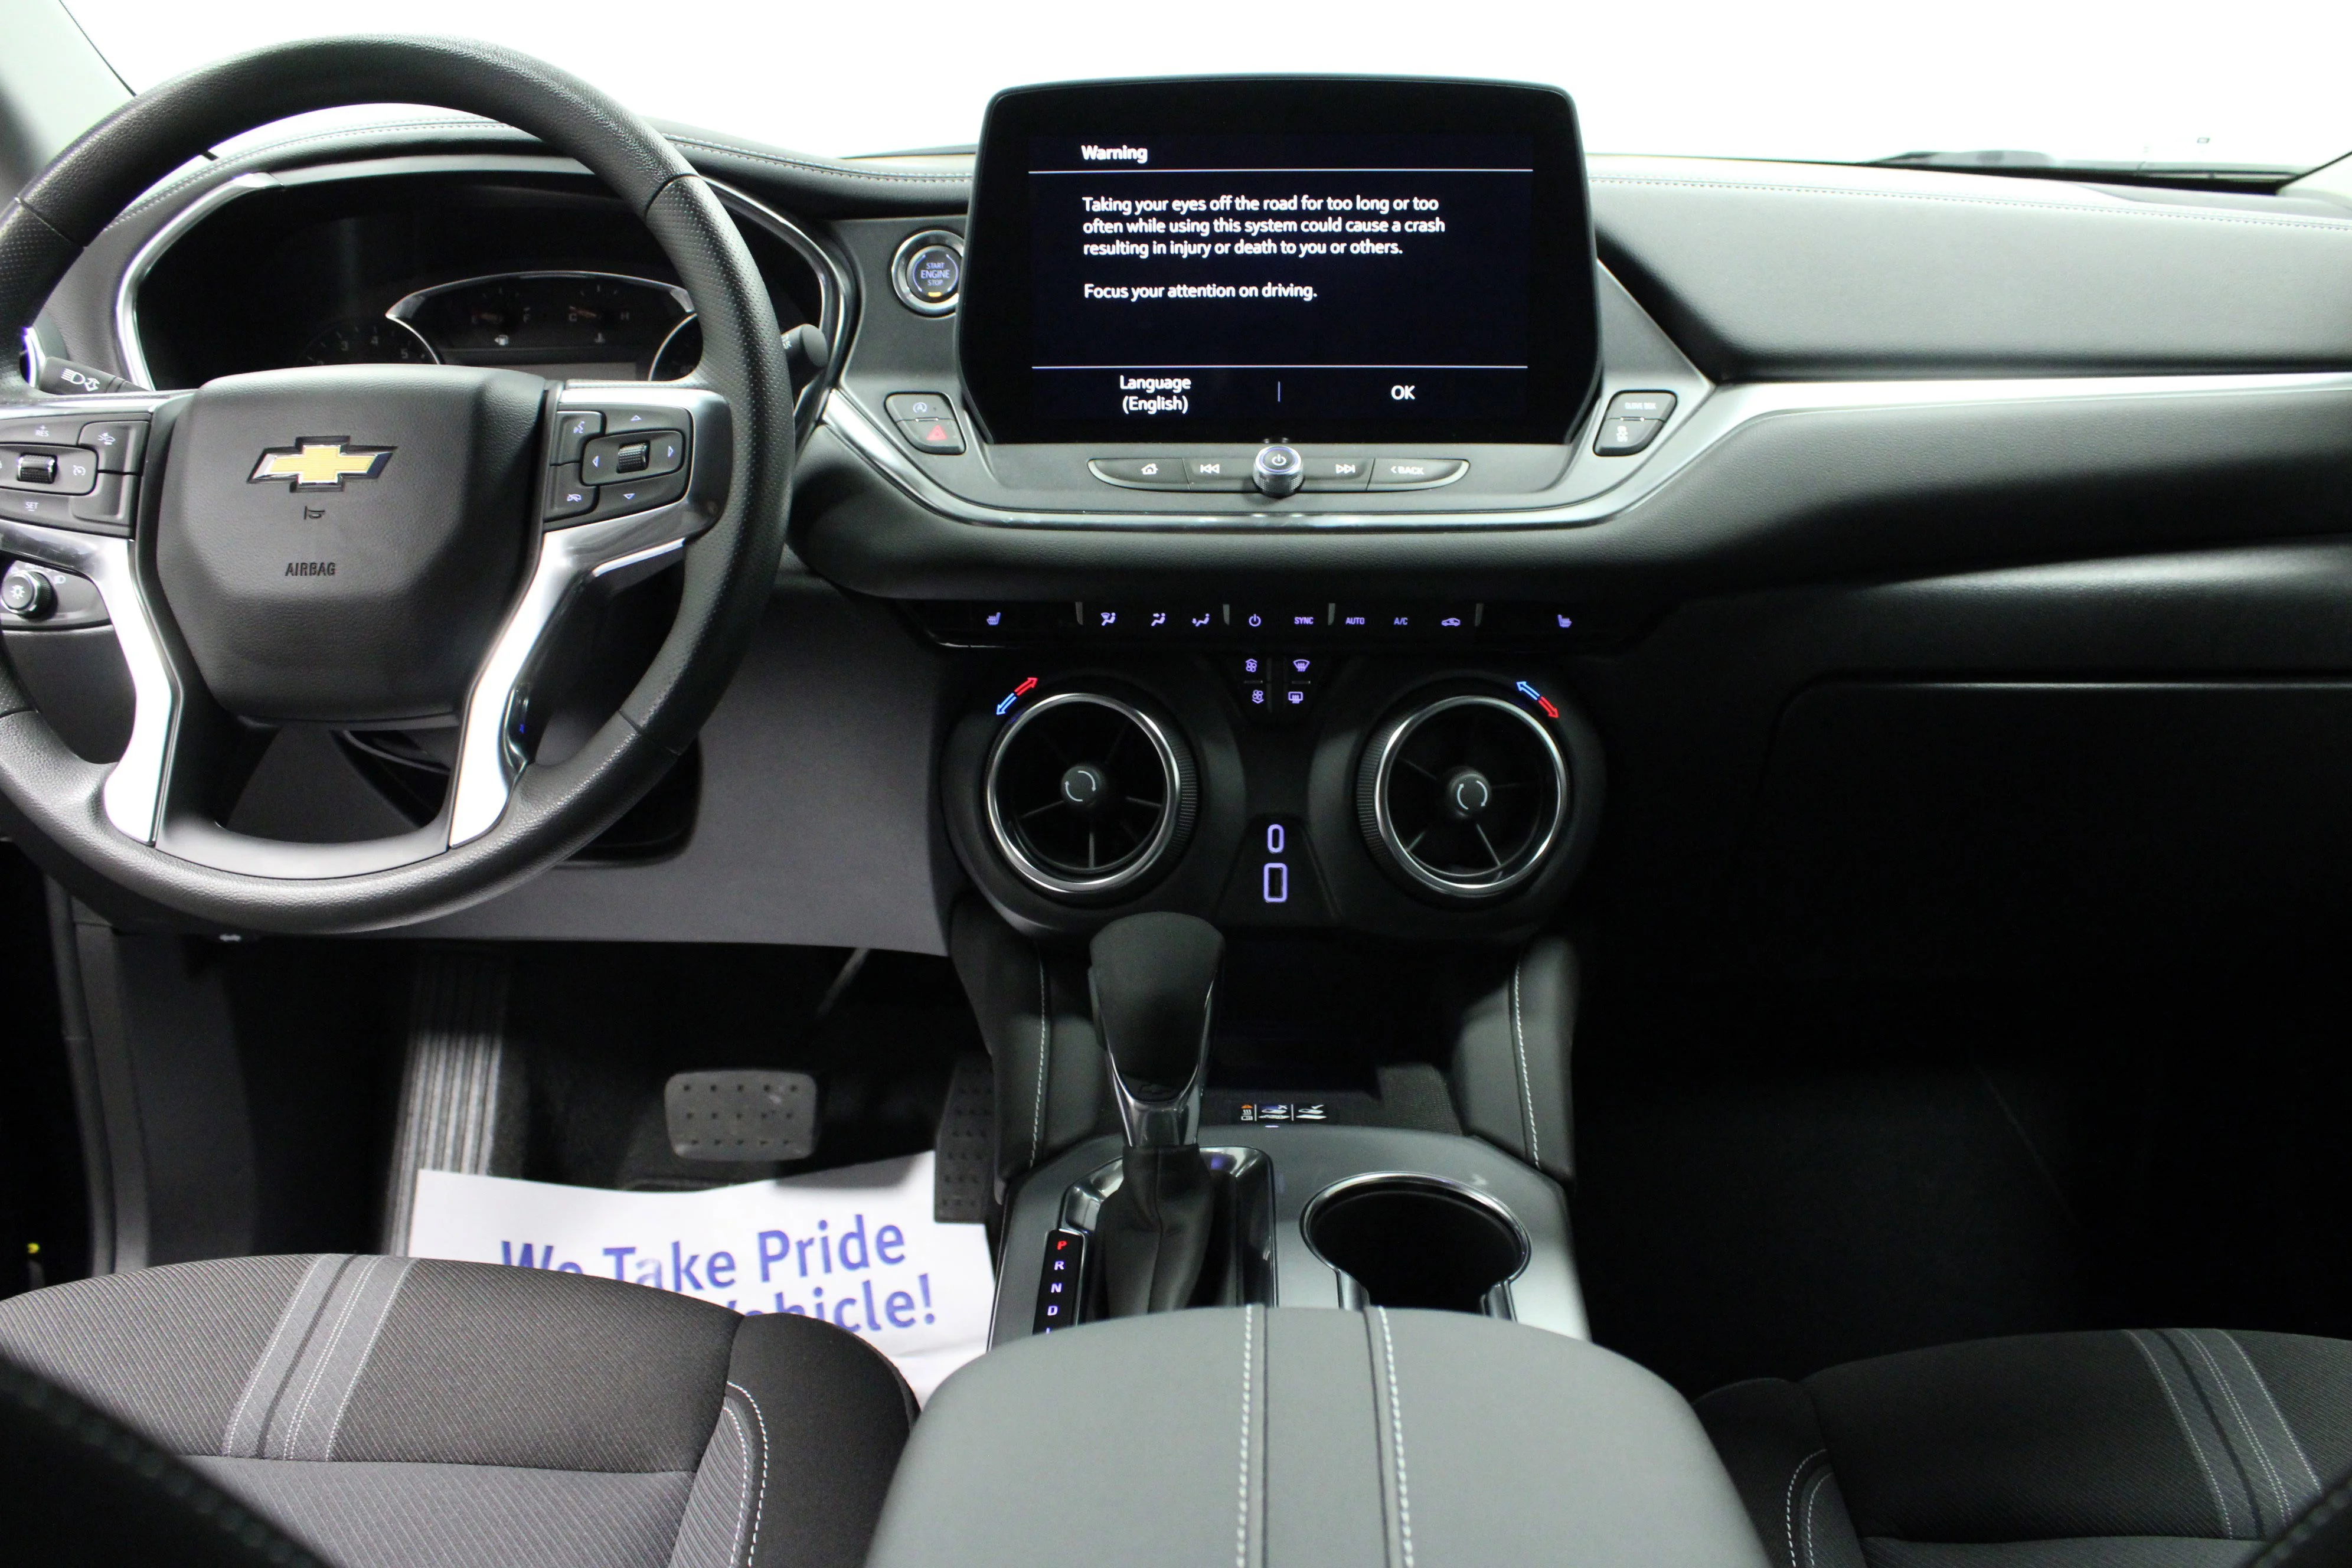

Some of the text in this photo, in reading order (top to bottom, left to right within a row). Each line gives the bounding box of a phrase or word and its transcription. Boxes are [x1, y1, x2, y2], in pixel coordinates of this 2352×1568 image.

[1080, 144, 1148, 164] Warning
[1082, 194, 1439, 216] Taking your eyes off the road for too long or too
[1083, 216, 1446, 237] often while using this system could cause a crash
[1083, 238, 1403, 259] resulting in injury or death to you or others.
[921, 270, 950, 279] ENGINE
[1084, 281, 1318, 302] Focus your attention on driving.
[1119, 374, 1192, 394] Language
[1390, 385, 1416, 400] OK
[1122, 395, 1189, 415] (English)
[285, 562, 336, 576] AIRBAG
[1294, 616, 1314, 625] SYNC
[1345, 617, 1365, 625] AUTO
[1393, 617, 1408, 625] A/C
[1057, 1240, 1067, 1250] P
[602, 1241, 736, 1292] Take
[757, 1214, 906, 1283] Pride
[1054, 1260, 1064, 1270] R
[1051, 1283, 1062, 1293] N
[1047, 1305, 1059, 1316] D
